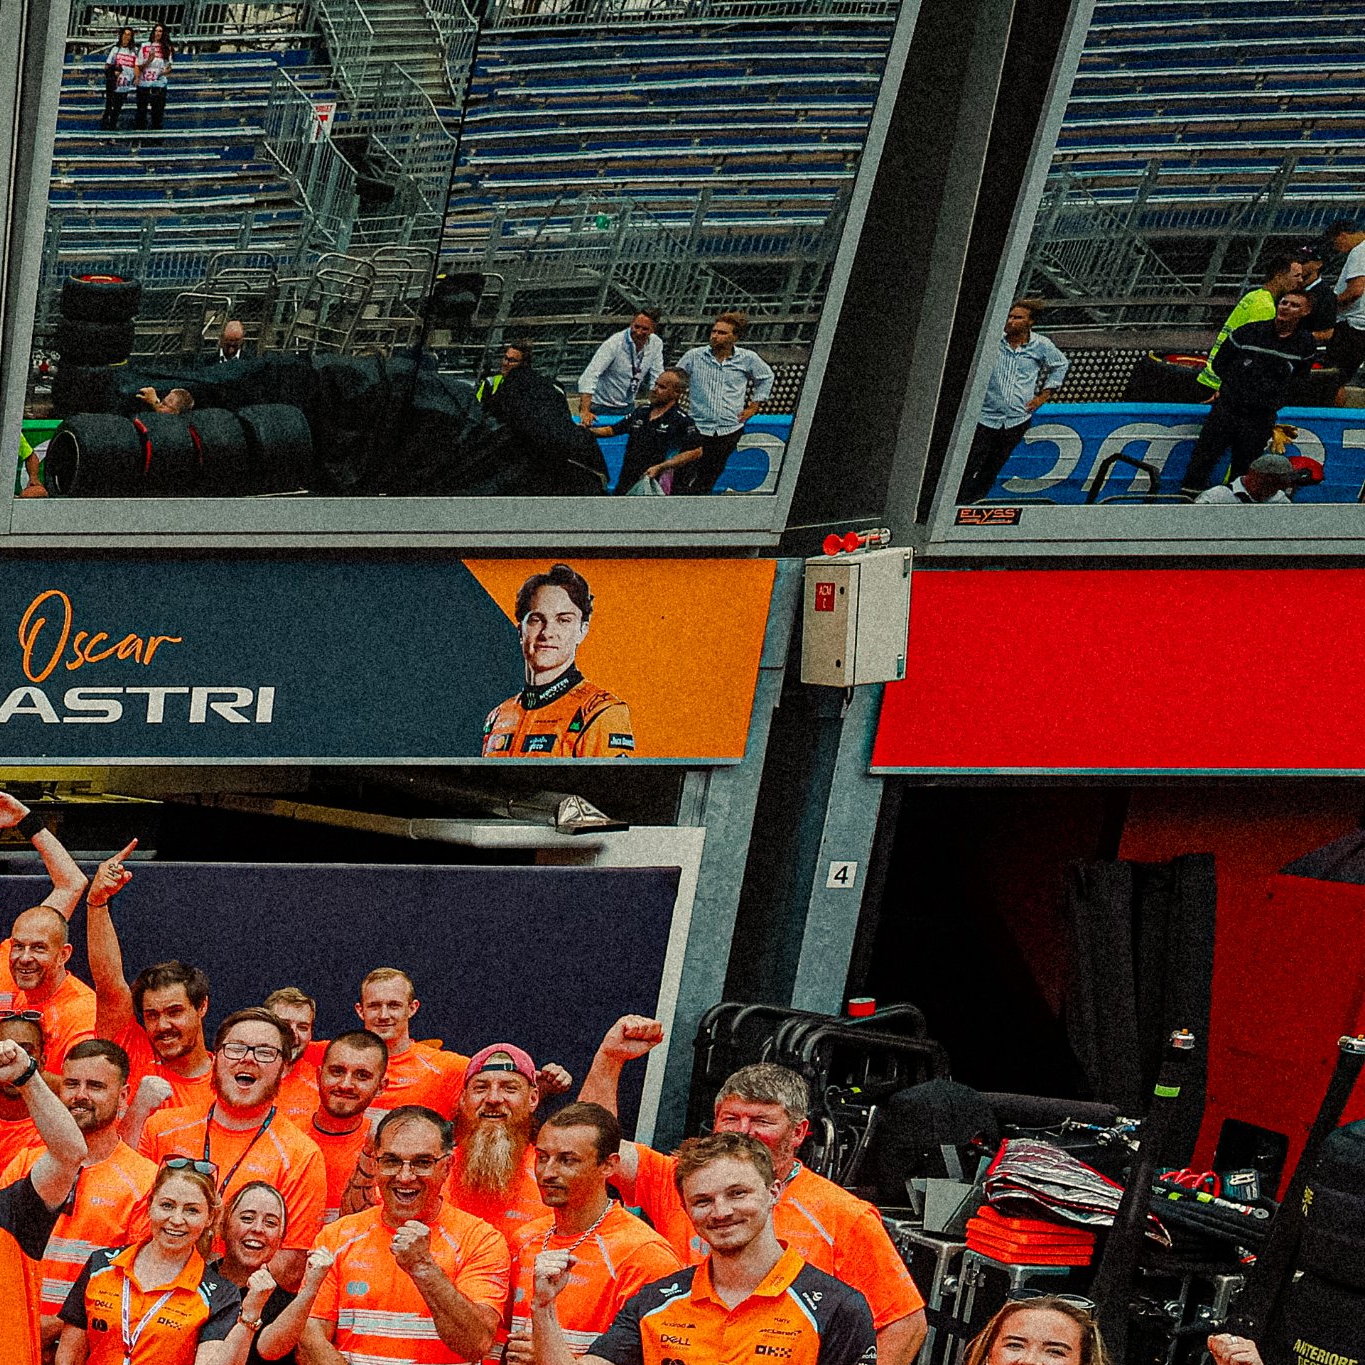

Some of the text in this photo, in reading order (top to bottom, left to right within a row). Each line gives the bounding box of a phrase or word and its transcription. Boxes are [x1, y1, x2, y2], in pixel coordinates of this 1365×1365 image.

[18, 590, 182, 682] Oscar
[833, 867, 849, 884] 4
[93, 1300, 114, 1309] DELL
[660, 1334, 691, 1346] DELL
